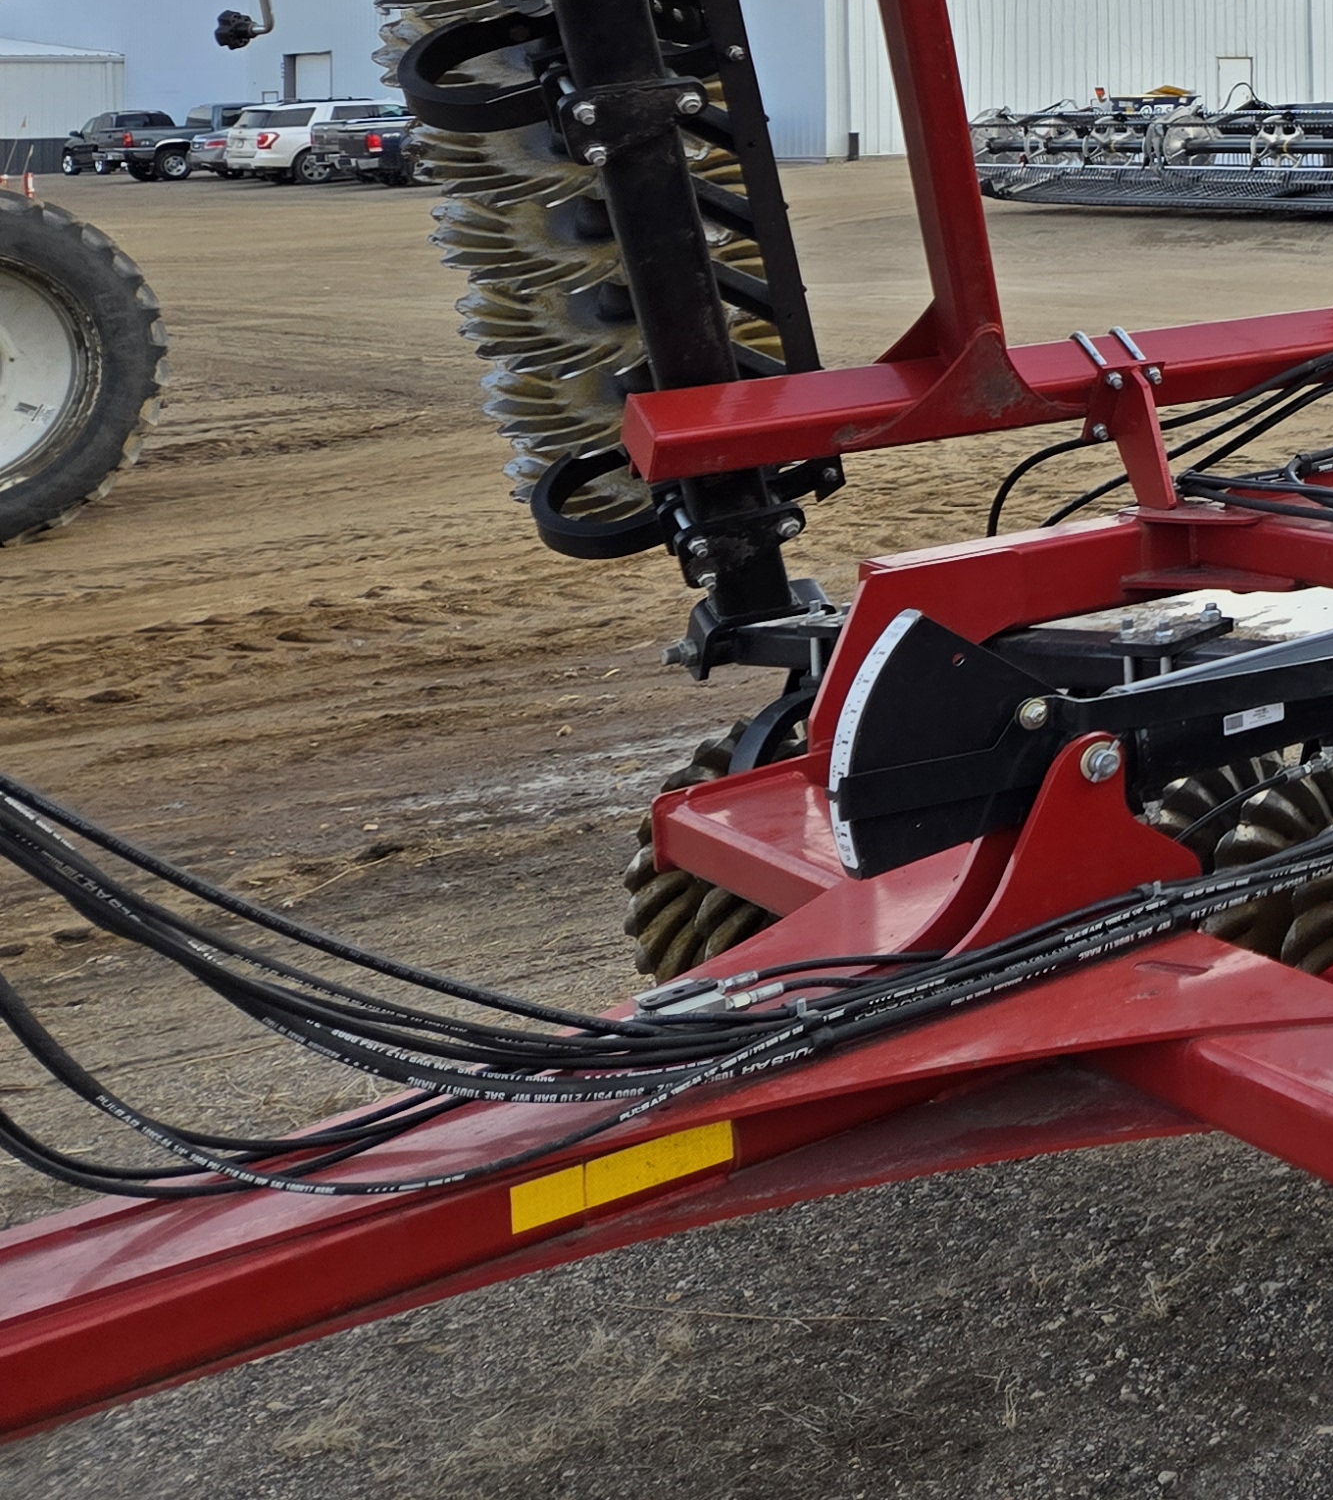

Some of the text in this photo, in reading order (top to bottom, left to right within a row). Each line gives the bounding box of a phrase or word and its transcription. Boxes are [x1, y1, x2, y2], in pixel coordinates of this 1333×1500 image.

[437, 1083, 480, 1099] 100R17
[483, 1090, 505, 1101] SAE
[592, 1090, 613, 1100] PSI
[613, 1086, 645, 1098] 3000
[510, 1092, 530, 1102] WP
[533, 1094, 557, 1102] BAR
[559, 1093, 582, 1102] 210
[94, 1092, 141, 1129] PULSAR
[617, 1092, 669, 1121] PULSAR
